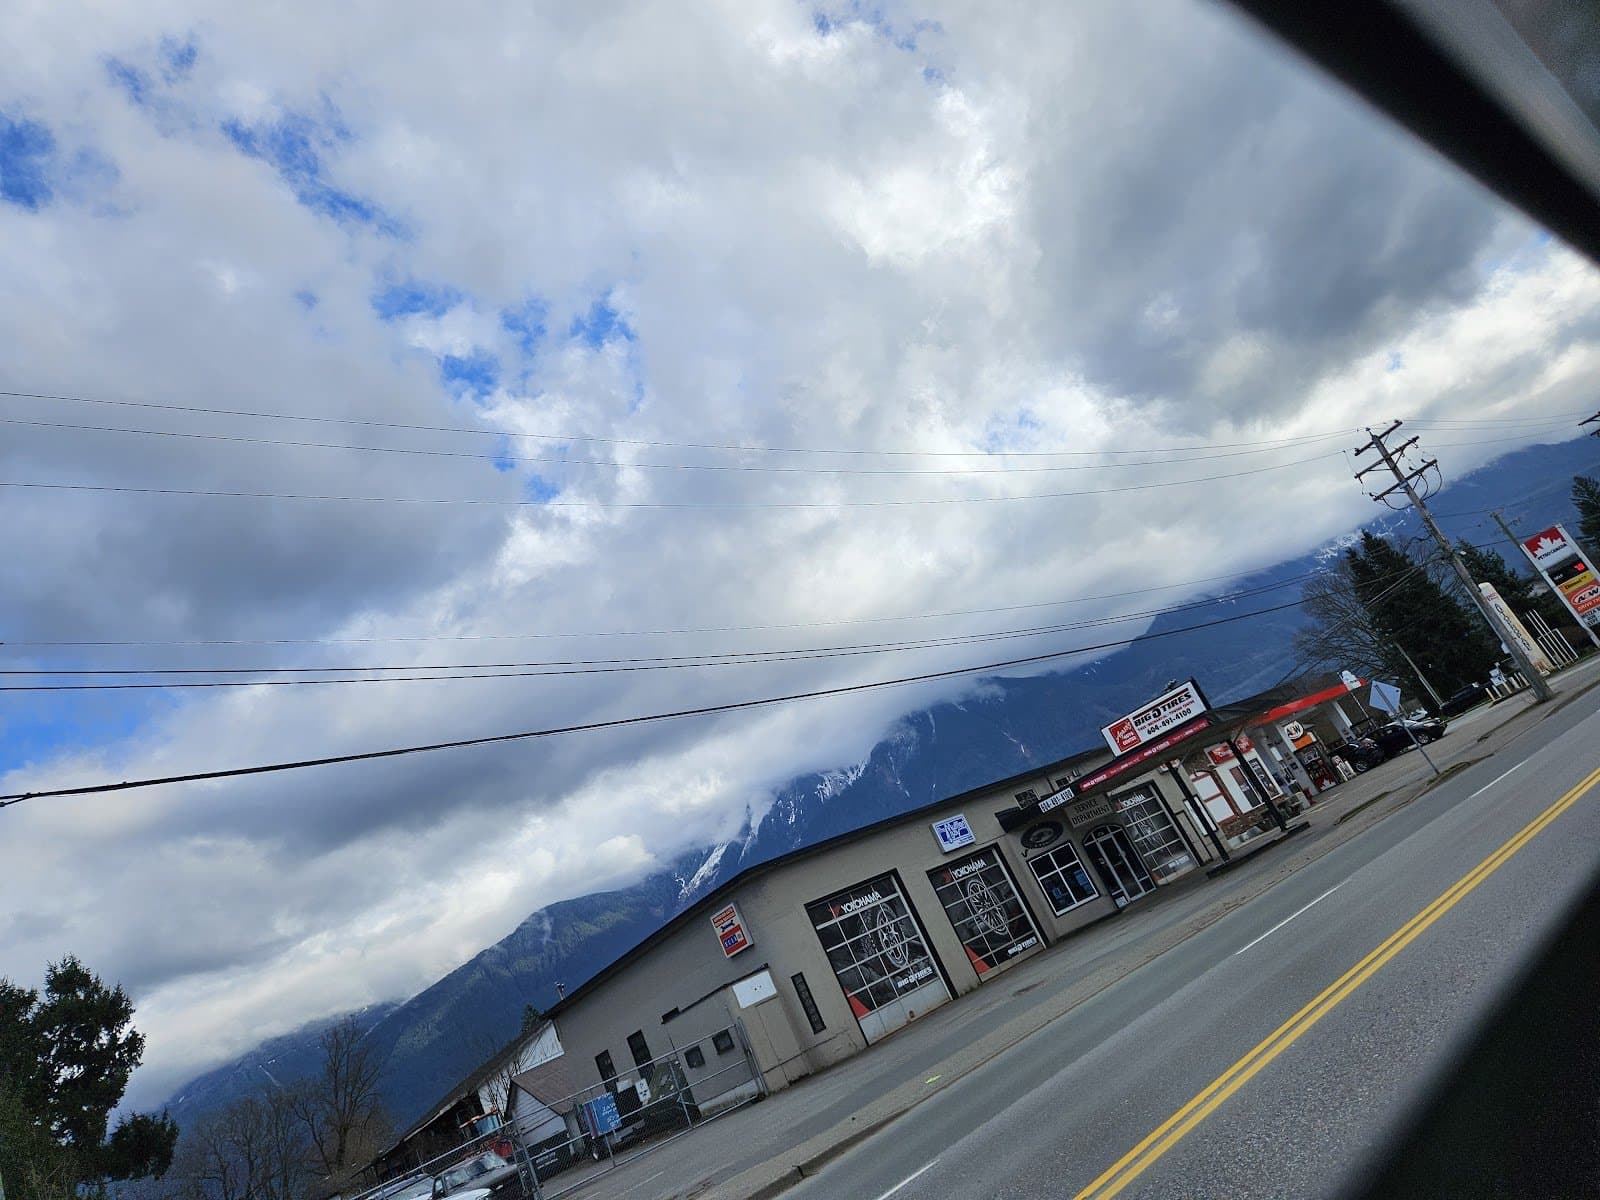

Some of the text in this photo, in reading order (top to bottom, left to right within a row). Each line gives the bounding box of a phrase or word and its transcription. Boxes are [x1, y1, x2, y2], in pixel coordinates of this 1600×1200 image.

[1134, 713, 1152, 727] BIG
[1161, 692, 1192, 712] TIRES
[1147, 708, 1191, 735] 604-491-4100
[1072, 805, 1109, 825] DEPARTMENT
[1075, 798, 1097, 813] SERVICE
[952, 859, 986, 878] YOKOHAMA
[841, 891, 881, 913] YOKOHAMA
